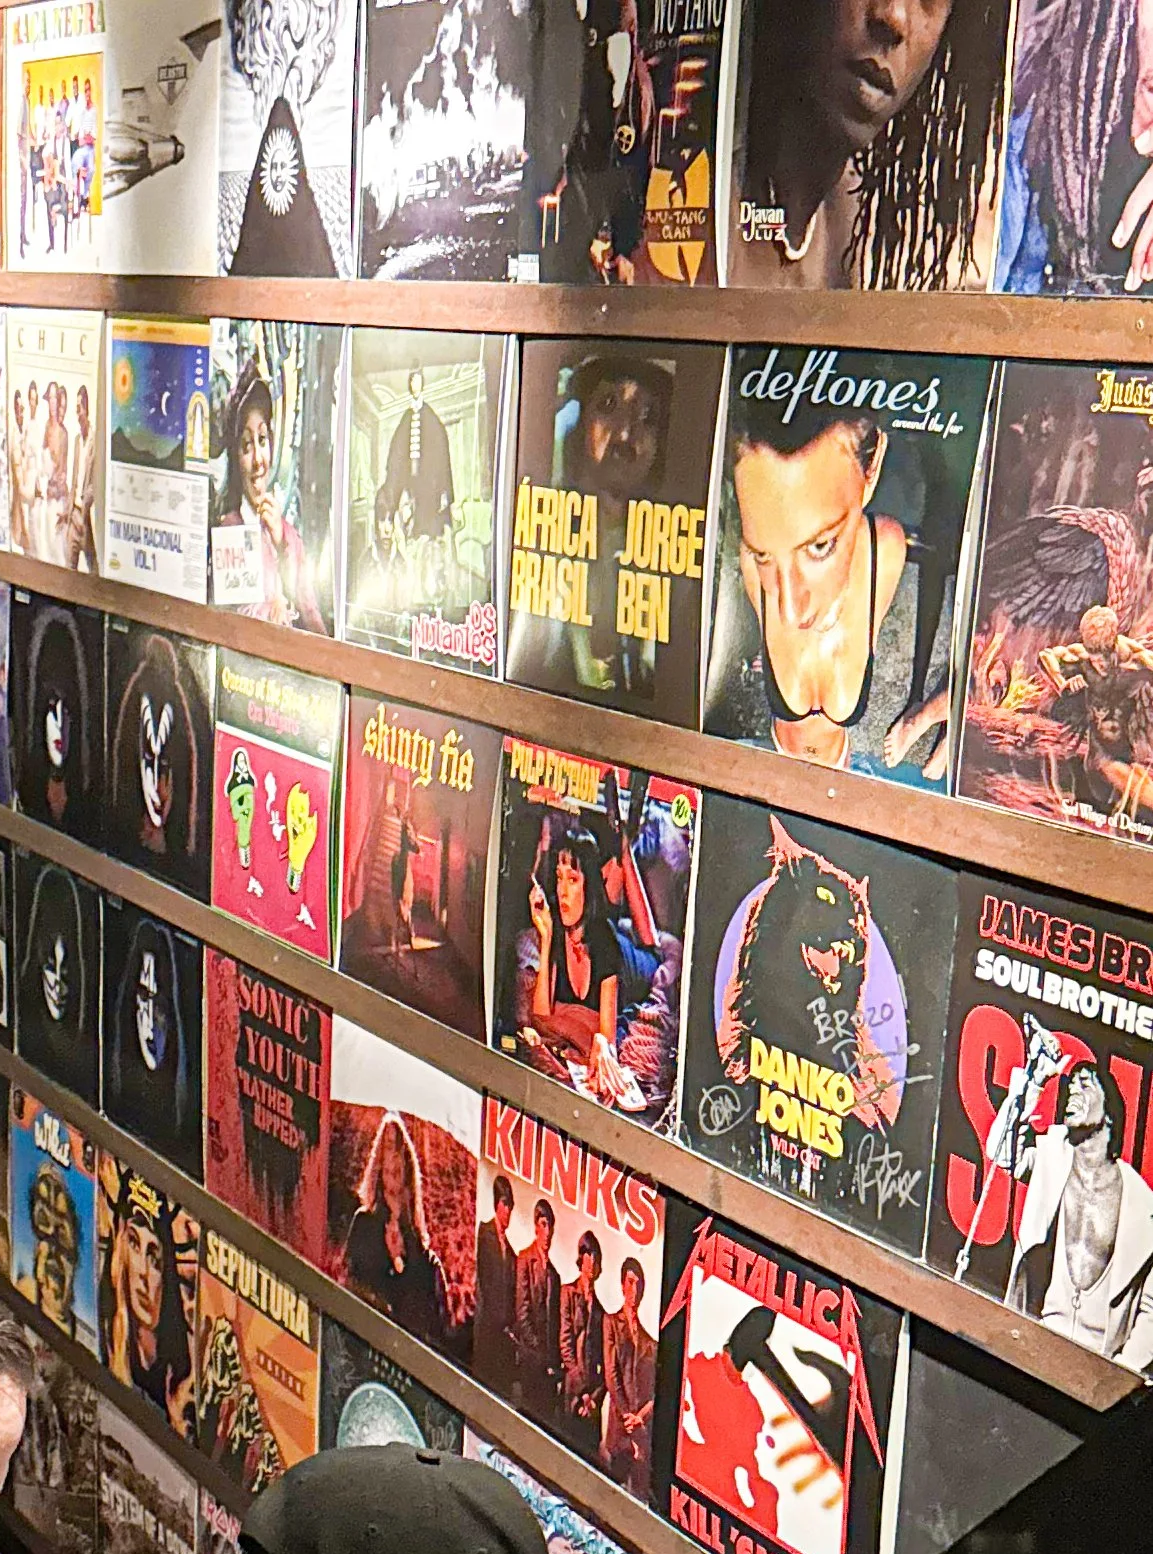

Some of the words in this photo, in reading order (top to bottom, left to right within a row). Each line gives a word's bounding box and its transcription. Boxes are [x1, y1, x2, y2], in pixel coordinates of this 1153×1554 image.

[52, 0, 106, 39] NEGRA
[645, 209, 707, 225] WU-TANG
[661, 224, 692, 240] CLAN
[739, 201, 785, 242] Djavan
[754, 228, 785, 241] LUZ
[739, 348, 942, 424] deftones
[891, 411, 931, 431] around
[942, 411, 964, 439] fur
[142, 526, 183, 554] RACIONAL
[513, 476, 599, 561] ÁFRICA
[618, 498, 706, 580] JORGE
[510, 549, 594, 628] BRASIL
[616, 570, 672, 644] BEN
[411, 614, 497, 666] Mutantes
[361, 701, 436, 786] skinty
[437, 727, 476, 793] fia
[509, 740, 546, 786] PULP
[544, 750, 601, 804] FICTION
[978, 893, 1096, 973] JAMES
[1098, 931, 1153, 997] BR
[238, 973, 310, 1045] SONIC
[974, 947, 1153, 1041] SOULBROTHE
[244, 1025, 321, 1100] YOUTH
[749, 1035, 856, 1117] DANKO
[755, 1082, 845, 1158] JONES
[770, 1132, 799, 1161] WILD
[799, 1147, 824, 1172] CAT
[483, 1092, 660, 1248] KINKS
[205, 1229, 312, 1346] SEPULTURA
[668, 1483, 726, 1554] KILL
